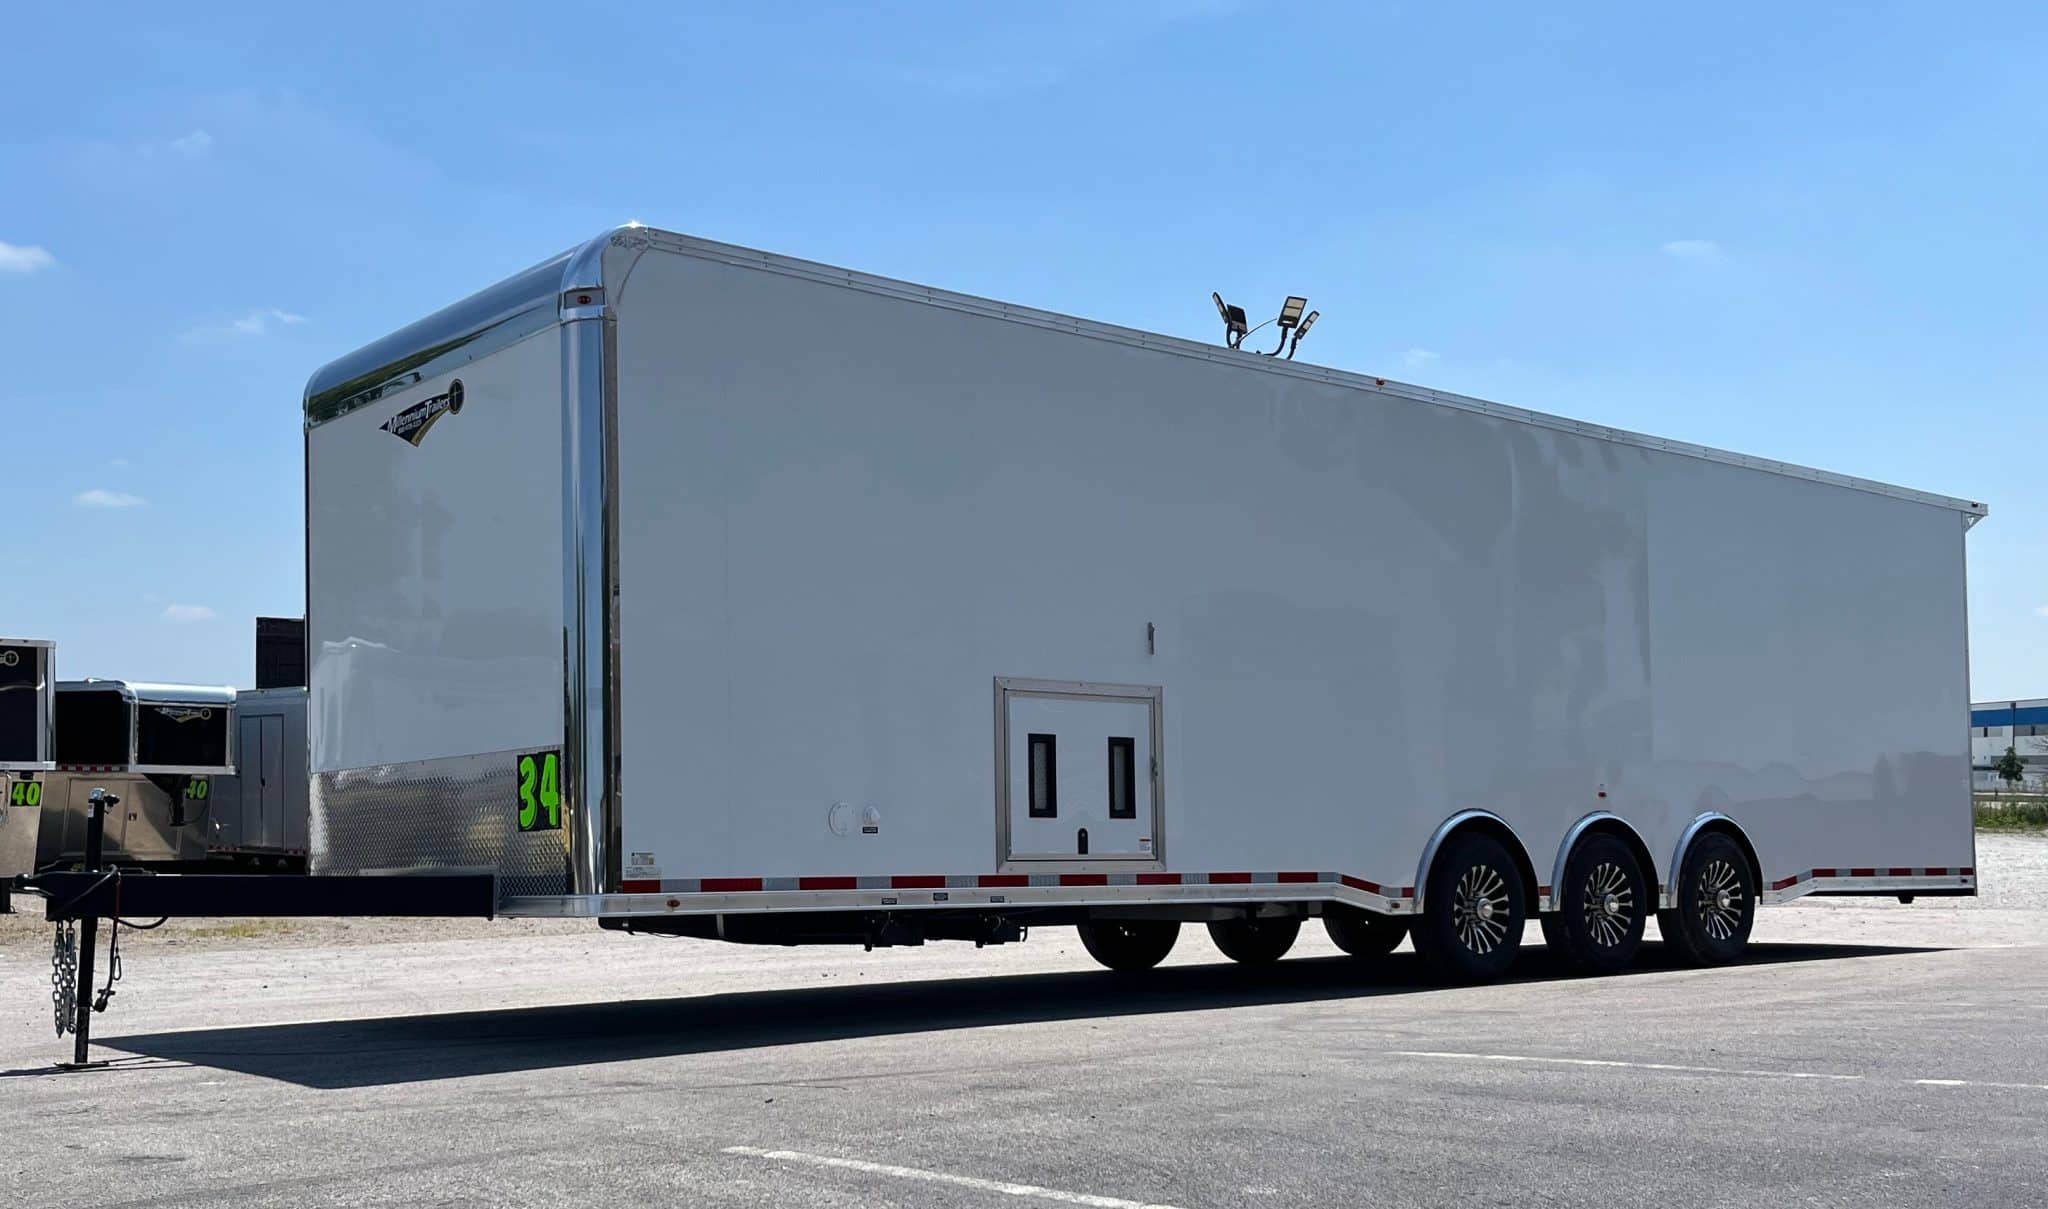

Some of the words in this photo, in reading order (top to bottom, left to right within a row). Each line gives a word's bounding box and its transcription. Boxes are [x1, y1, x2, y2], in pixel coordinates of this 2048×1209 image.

[12, 782, 41, 806] 40
[186, 780, 208, 799] 40
[520, 753, 559, 829] 34
